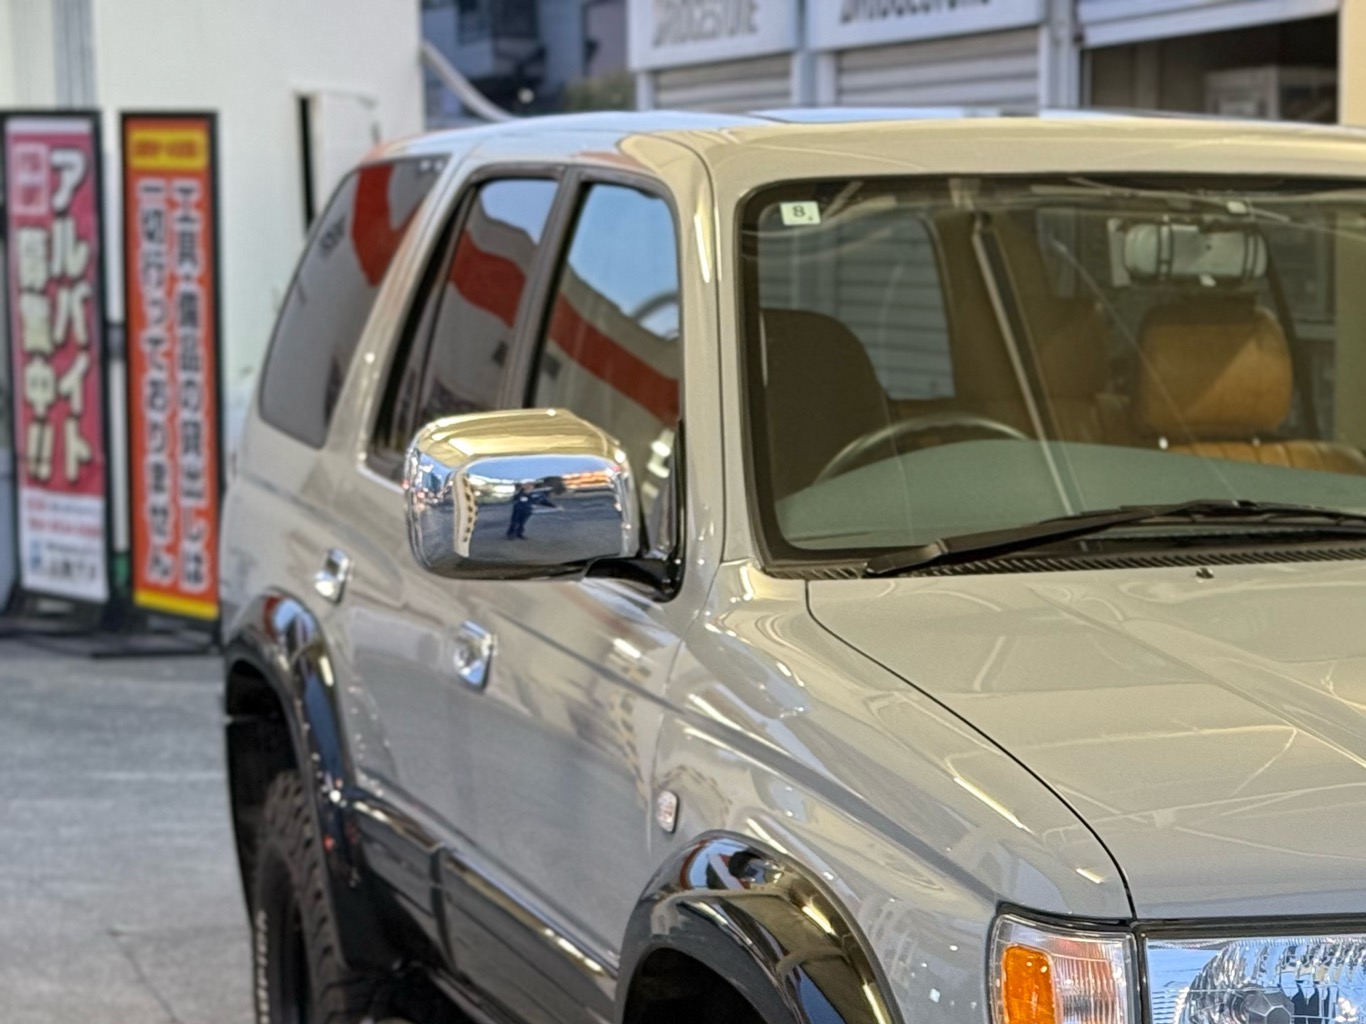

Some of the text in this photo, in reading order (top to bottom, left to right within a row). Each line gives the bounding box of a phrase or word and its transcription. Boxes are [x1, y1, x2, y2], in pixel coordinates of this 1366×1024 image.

[50, 148, 92, 482] アルバイト
